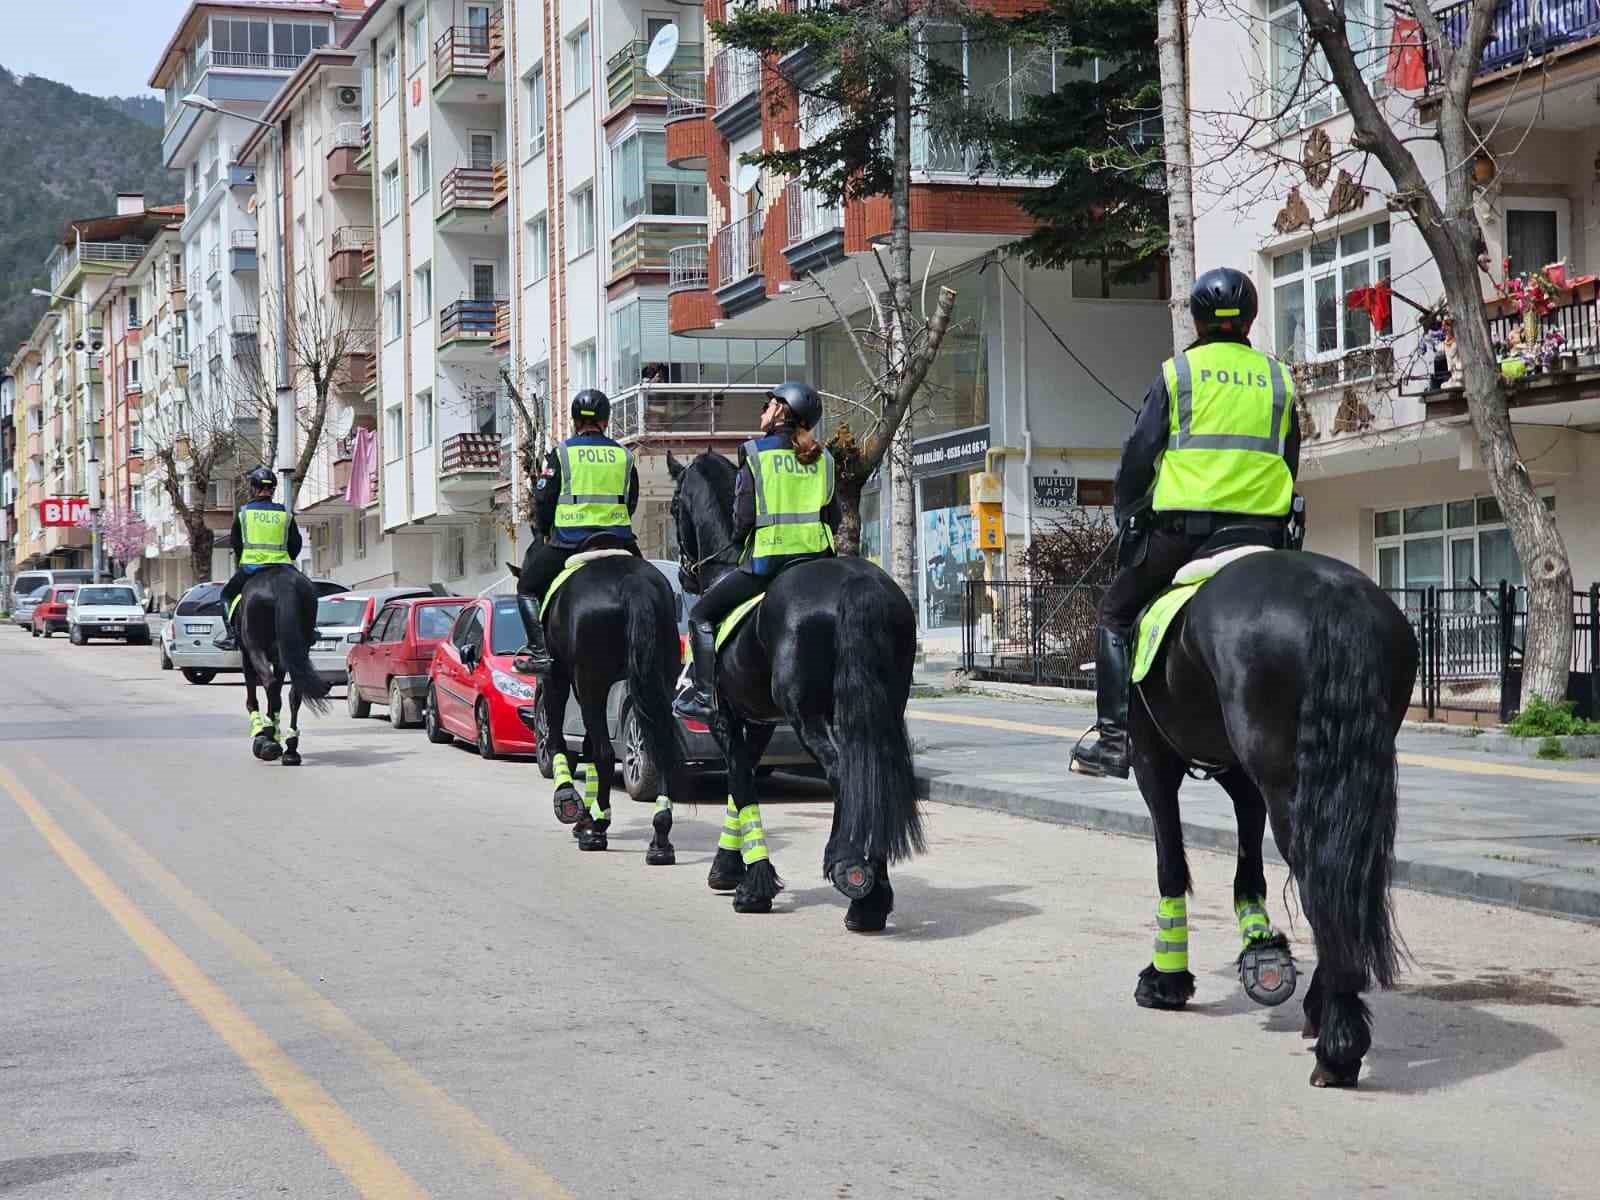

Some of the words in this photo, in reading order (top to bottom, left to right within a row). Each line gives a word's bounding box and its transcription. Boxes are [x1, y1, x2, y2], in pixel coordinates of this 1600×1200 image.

[1038, 478, 1072, 487] MUTLU
[1046, 488, 1064, 497] APT
[45, 499, 91, 522] BİM
